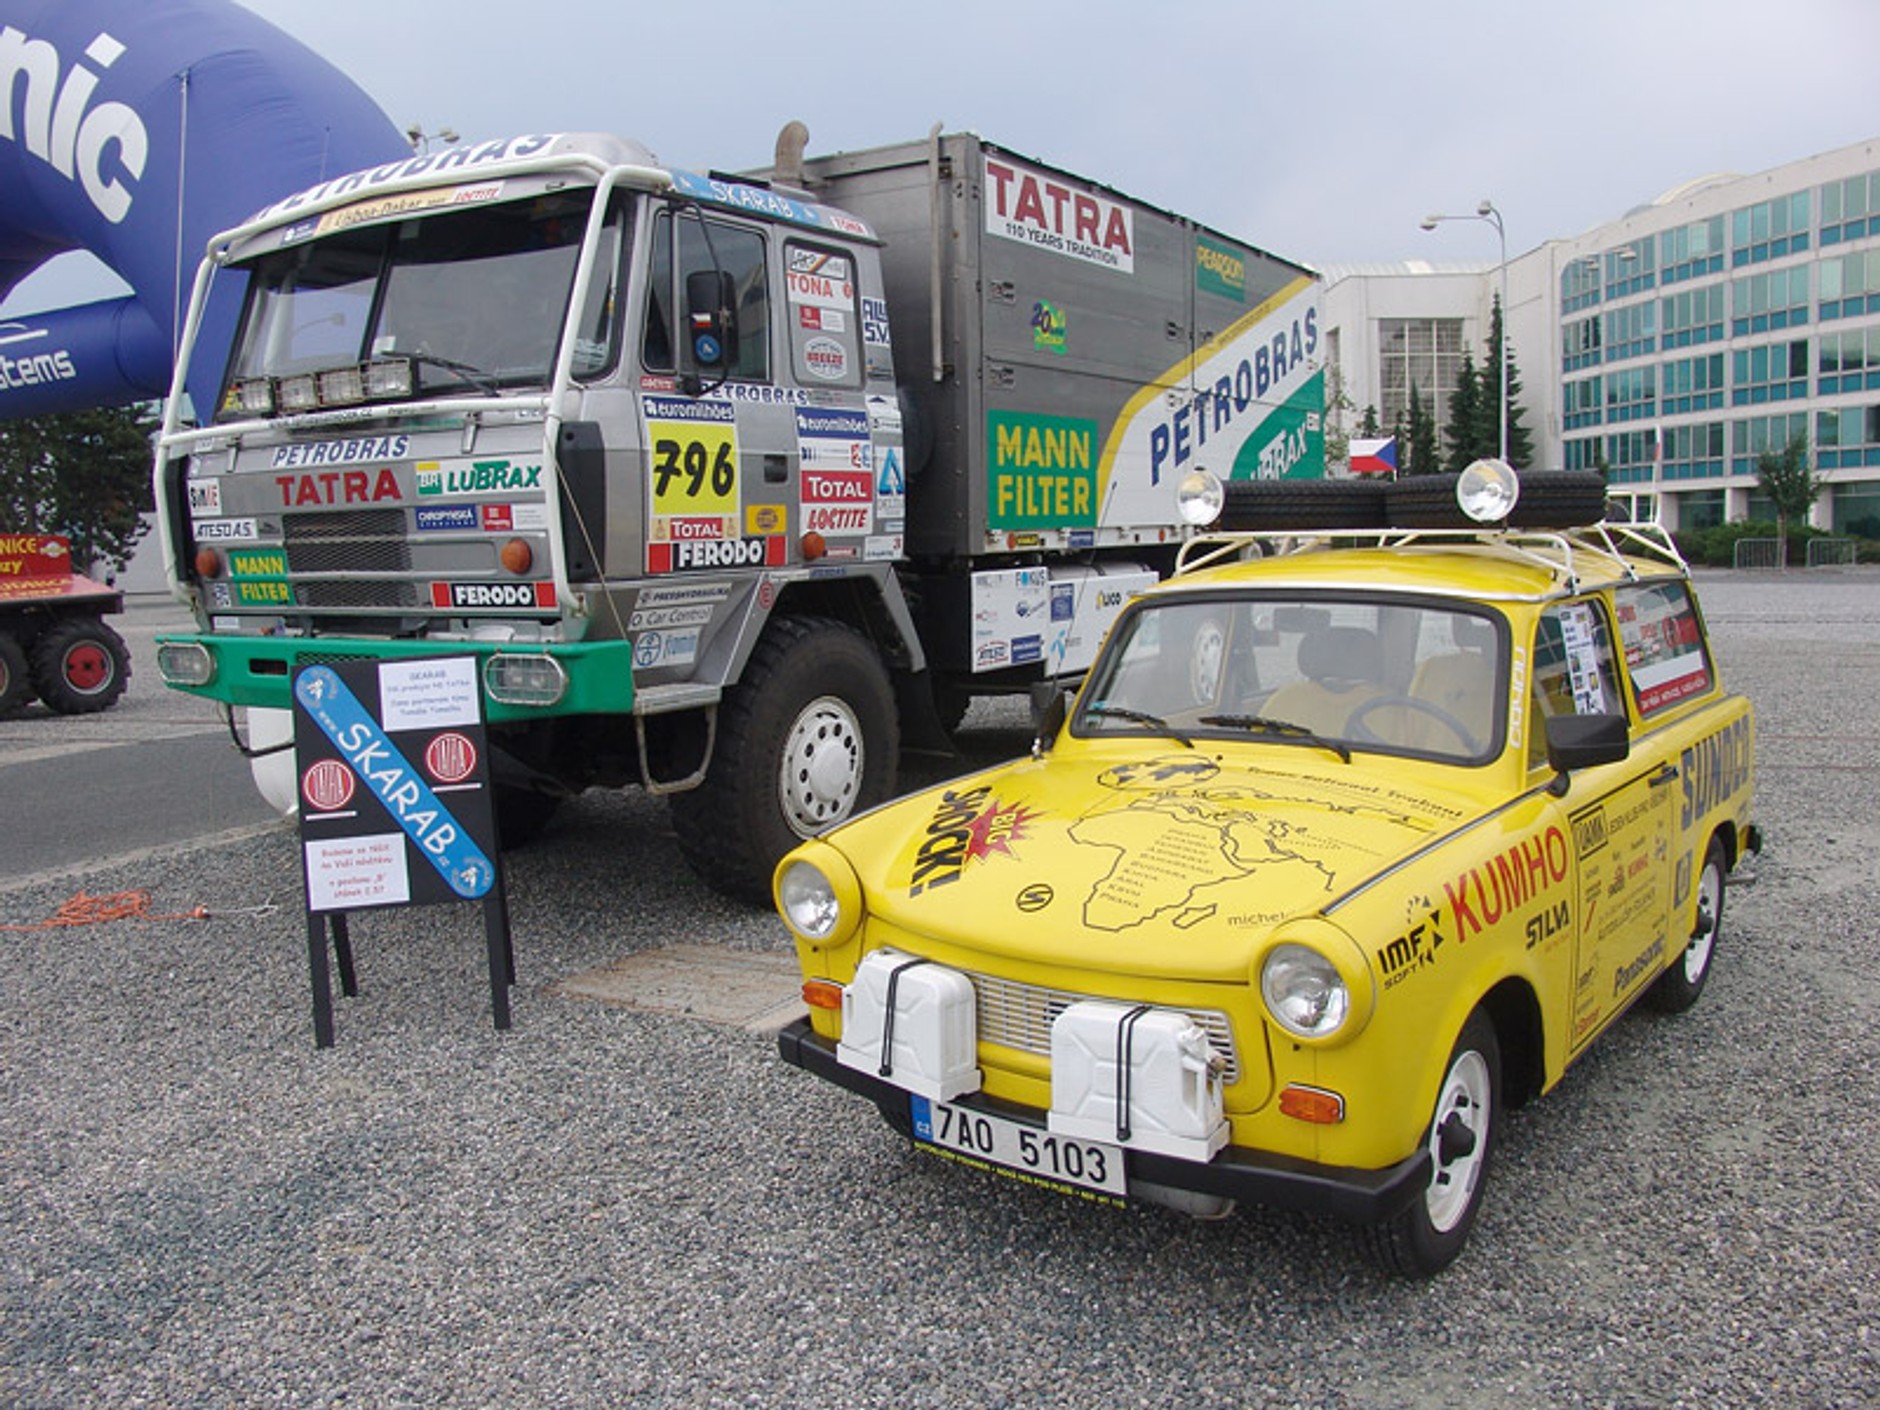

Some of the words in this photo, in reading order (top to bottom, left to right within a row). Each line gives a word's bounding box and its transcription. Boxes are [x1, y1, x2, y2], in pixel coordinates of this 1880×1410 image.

[709, 181, 793, 218] SKARAB
[987, 161, 1132, 256] TATRA
[1006, 223, 1025, 238] 110
[1027, 228, 1063, 250] YEARS
[1066, 240, 1118, 265] TRADITION
[787, 273, 833, 298] TONA
[1151, 306, 1317, 487] PETROBRAS
[273, 435, 409, 466] PETROBRAS
[997, 424, 1090, 468] MANN
[447, 460, 541, 492] LUBRAX
[654, 440, 734, 497] 796
[276, 468, 402, 507] TATRA
[808, 477, 867, 497] TOTAL
[998, 475, 1090, 516] FILTER
[672, 521, 723, 538] TOTAL
[808, 508, 868, 530] LOCTITE
[235, 557, 283, 575] MANN
[679, 541, 763, 567] FERODO
[240, 582, 289, 600] FILTER
[455, 586, 531, 604] FERODO
[646, 611, 666, 625] Car
[669, 608, 711, 624] Control
[337, 723, 456, 855] SKARAB
[909, 786, 993, 898] SHOCK!
[986, 812, 1016, 845] BIG
[1443, 826, 1569, 943] KUMHO
[1378, 923, 1427, 974] IMF
[1384, 963, 1418, 990] SOFT
[1019, 1129, 1107, 1183] 5103
